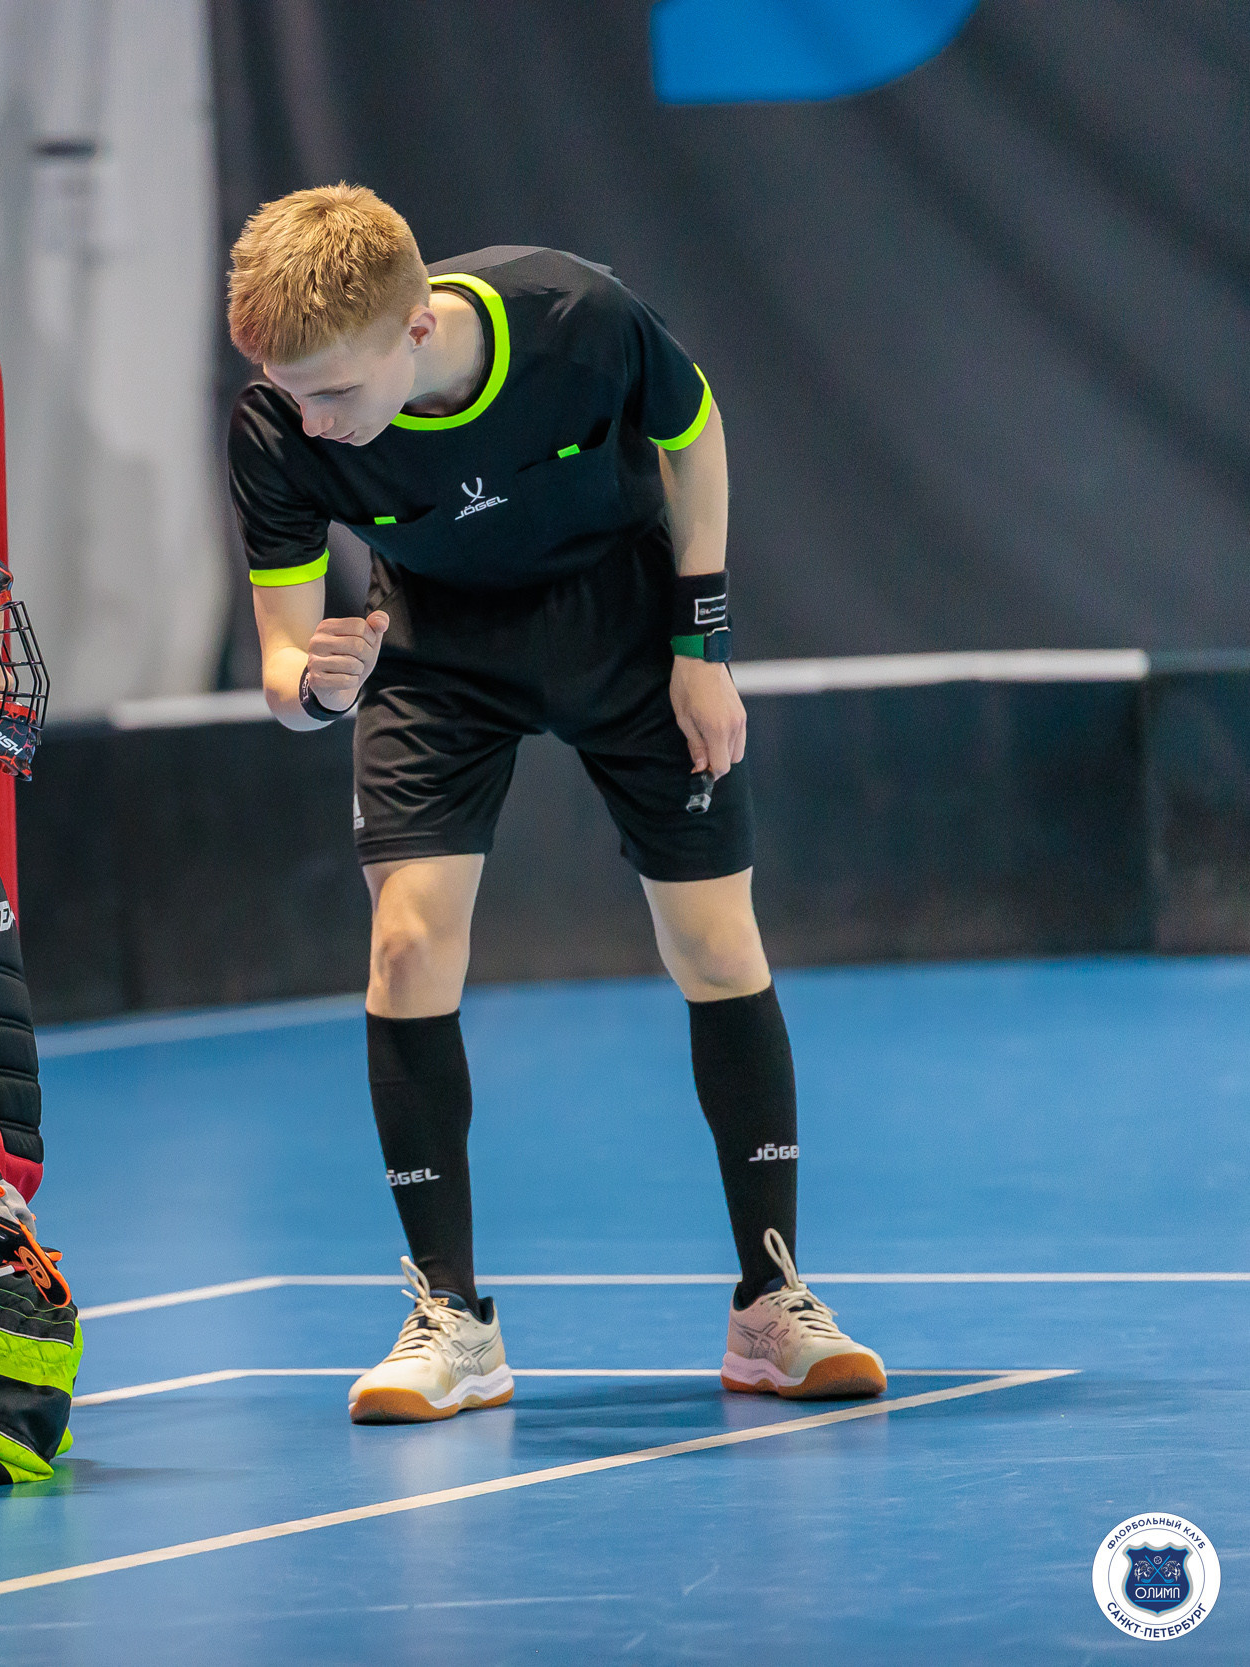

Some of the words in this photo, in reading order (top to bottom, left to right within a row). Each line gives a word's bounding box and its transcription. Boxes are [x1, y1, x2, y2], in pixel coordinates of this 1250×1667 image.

[454, 496, 508, 520] JÖGEL
[748, 1143, 800, 1162] JÖGE
[385, 1167, 440, 1187] ÖGEL
